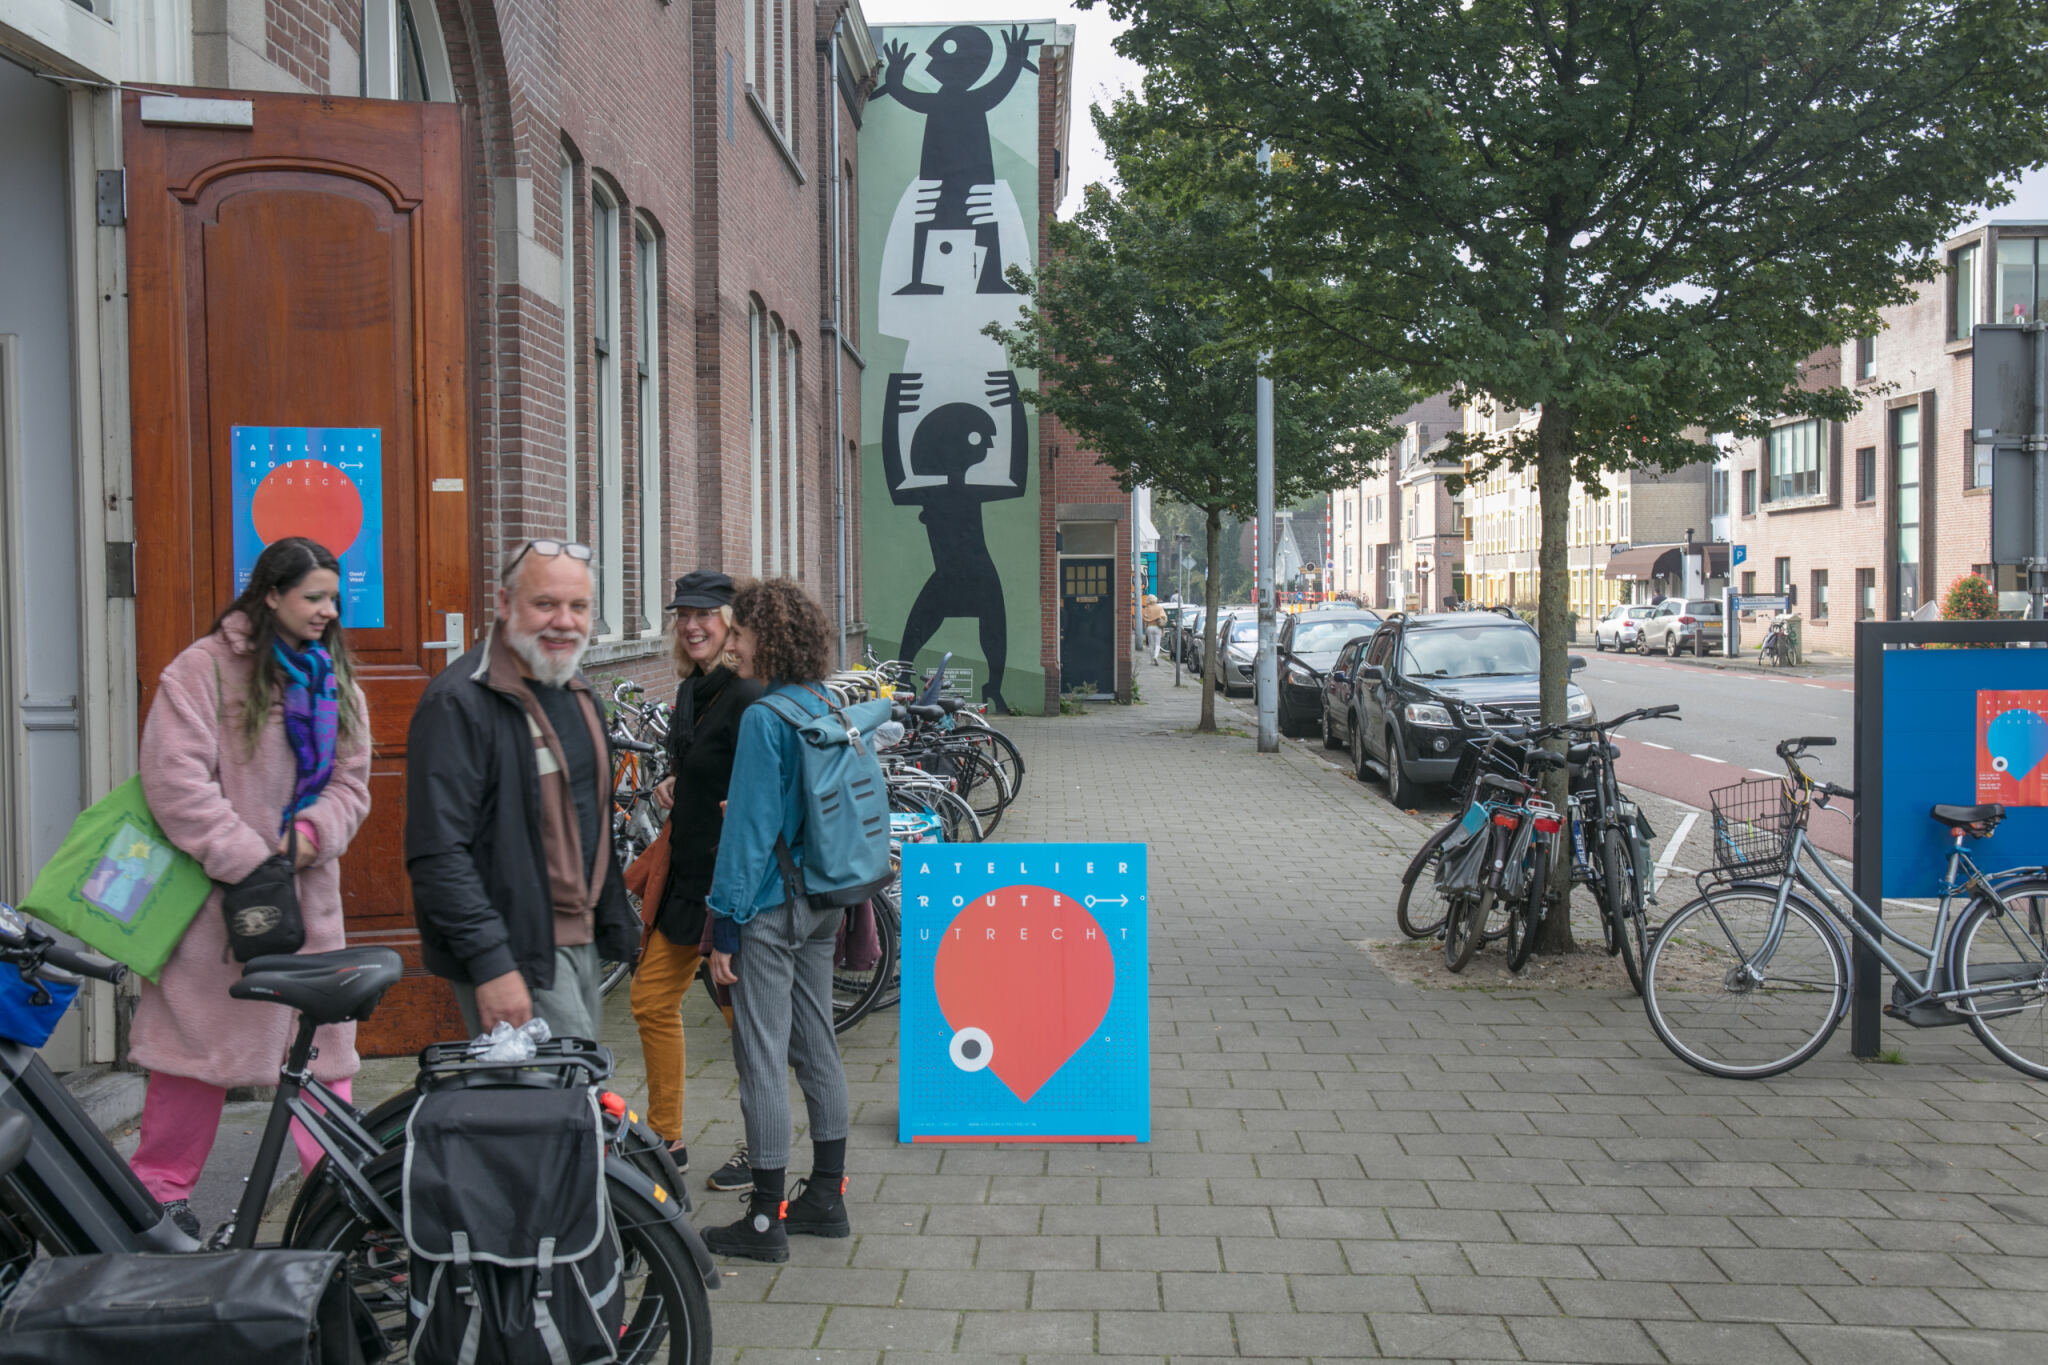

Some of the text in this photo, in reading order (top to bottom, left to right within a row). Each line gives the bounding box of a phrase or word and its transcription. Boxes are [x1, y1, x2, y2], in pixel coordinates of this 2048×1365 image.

[250, 443, 363, 452] ATELIER
[251, 478, 364, 486] UTRECHT
[919, 862, 1128, 875] ATELIER
[919, 895, 1061, 908] ROUTE
[920, 928, 1128, 941] UTRECHT
